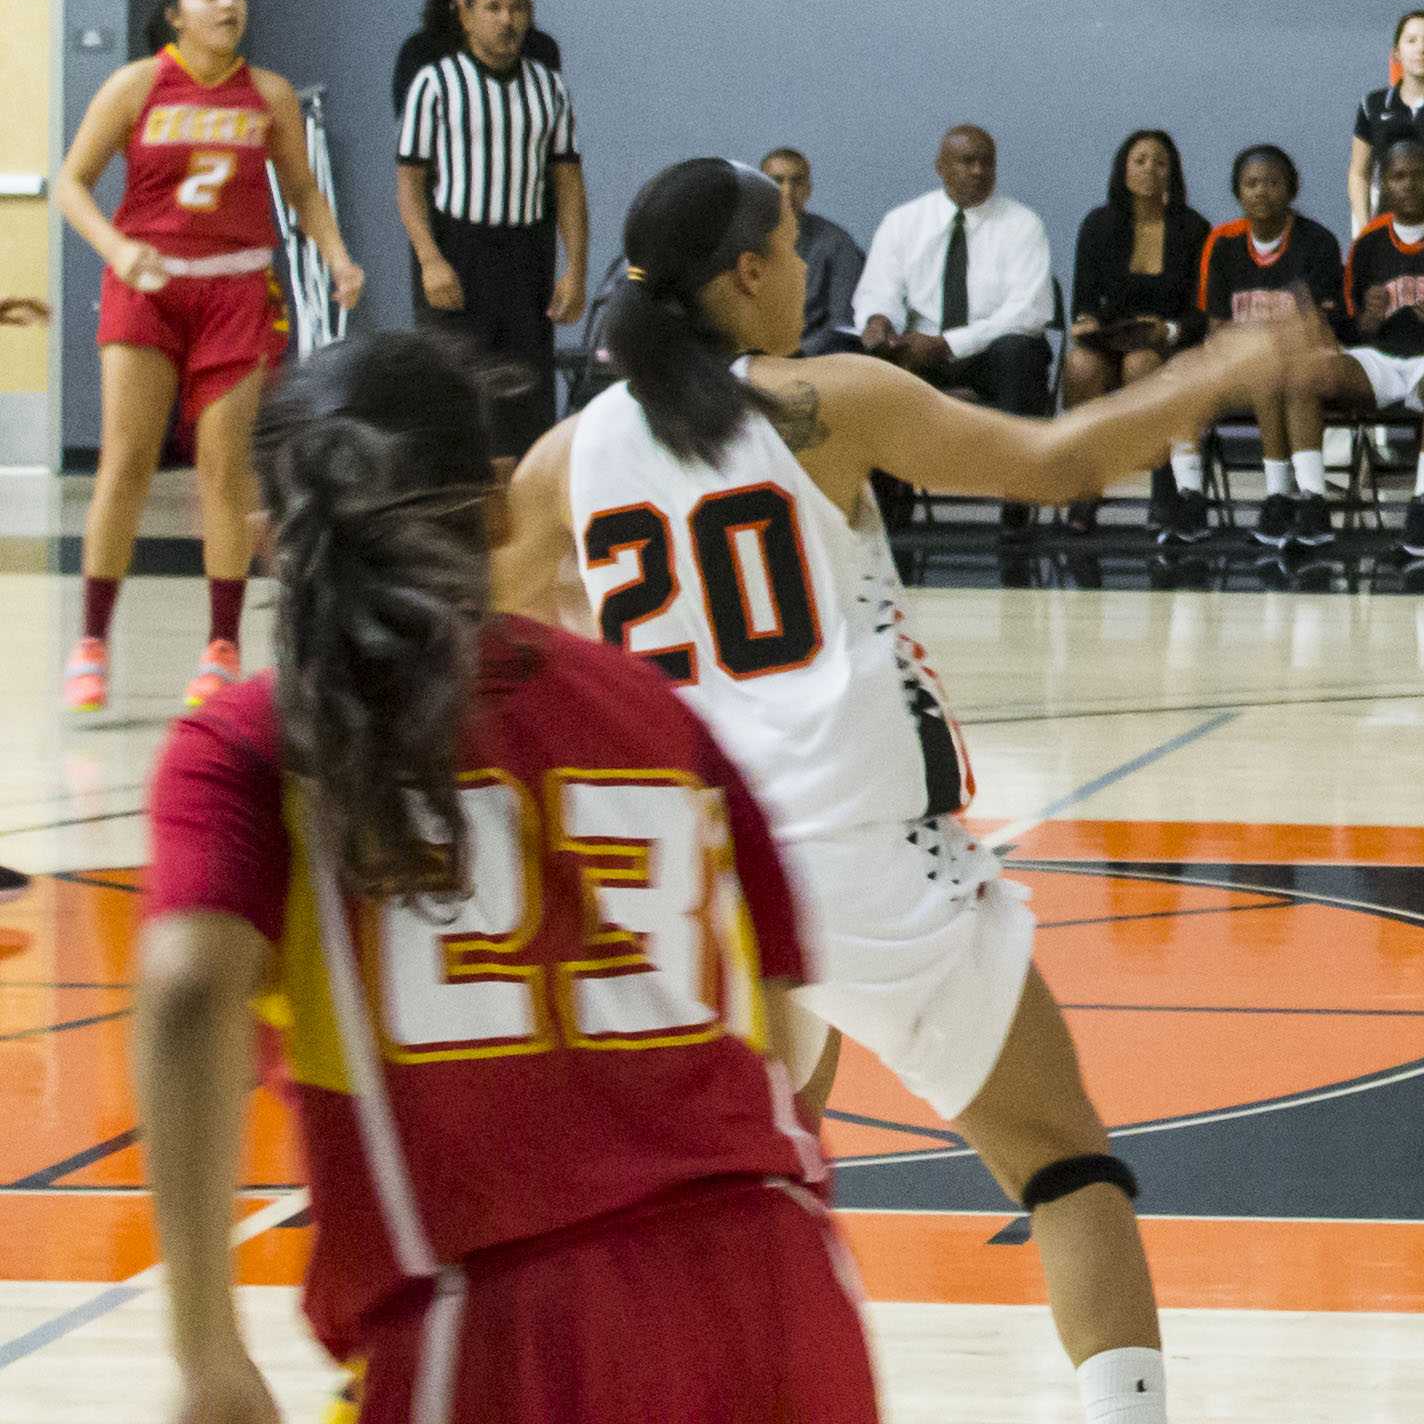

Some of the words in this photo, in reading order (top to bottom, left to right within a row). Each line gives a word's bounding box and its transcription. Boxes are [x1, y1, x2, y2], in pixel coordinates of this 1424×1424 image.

[176, 150, 239, 213] 2
[586, 481, 826, 686] 20
[376, 766, 731, 1065] 23
